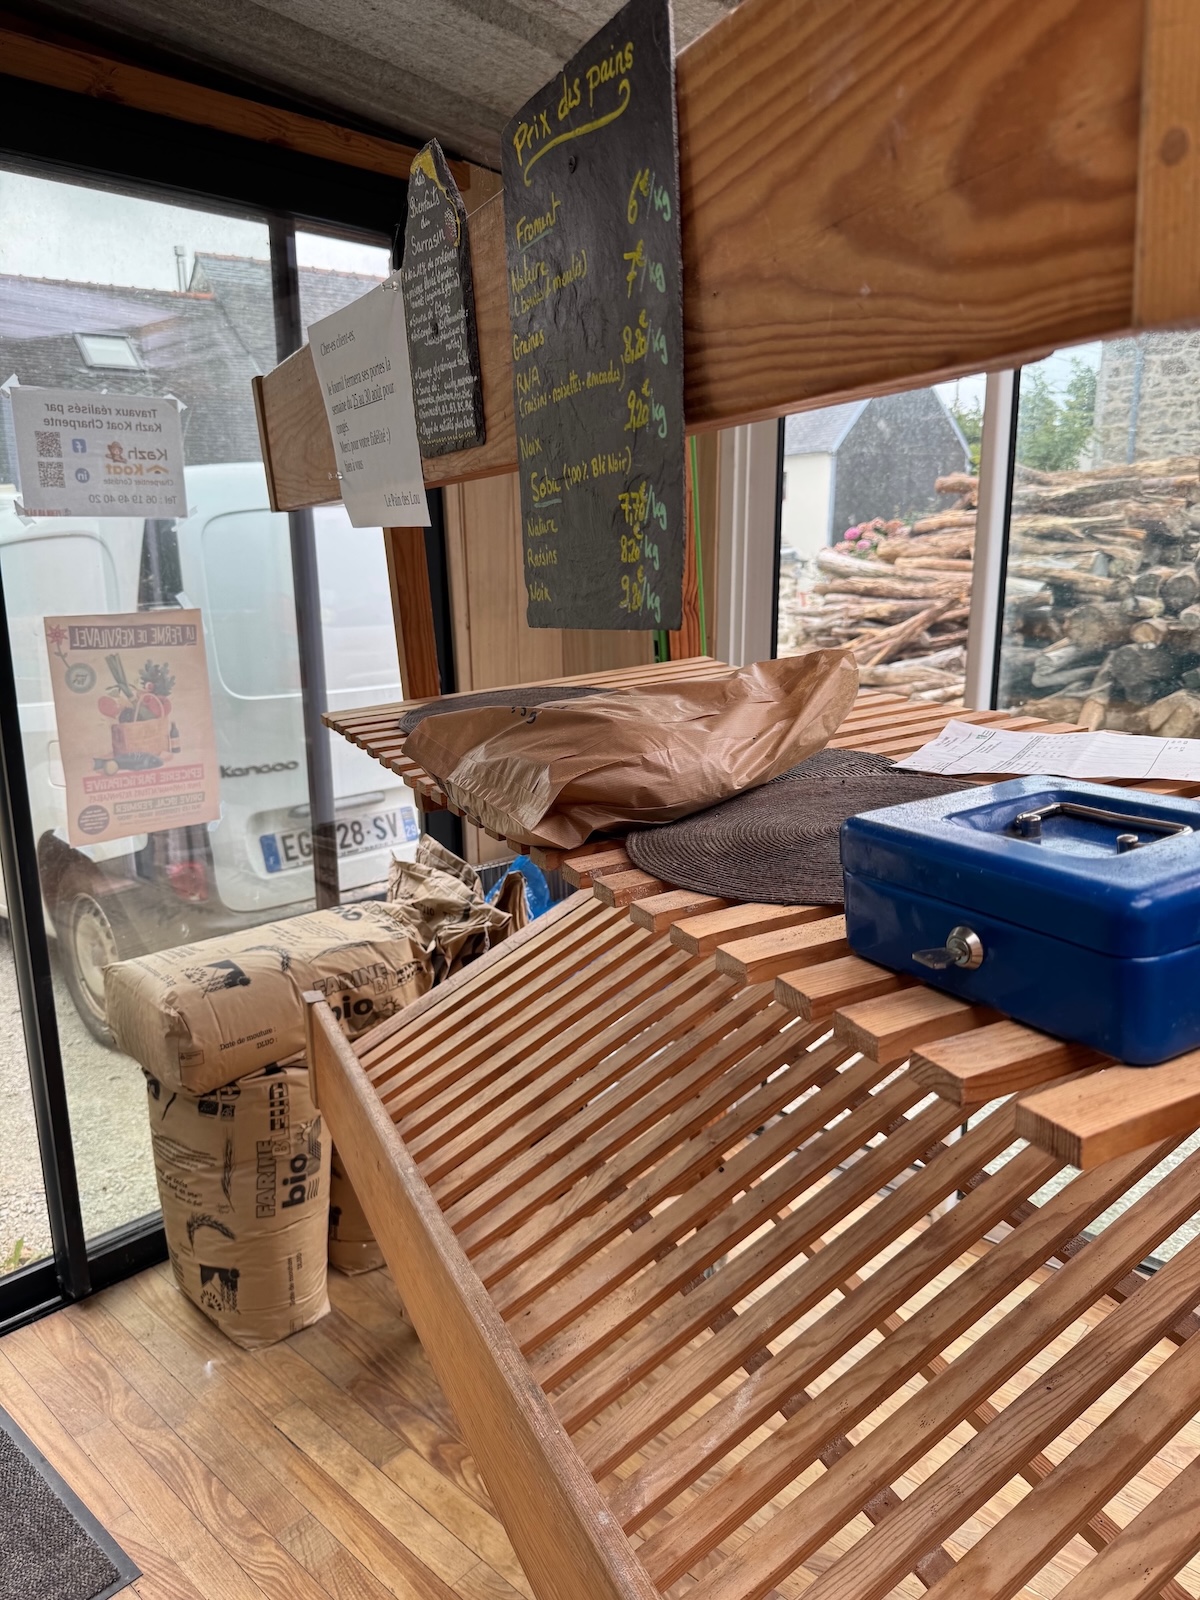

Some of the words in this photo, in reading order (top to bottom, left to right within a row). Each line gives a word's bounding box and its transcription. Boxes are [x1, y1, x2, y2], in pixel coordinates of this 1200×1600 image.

[513, 110, 551, 166] Prix
[558, 73, 581, 121] des
[586, 42, 634, 108] pains
[409, 187, 440, 219] Bienfaits
[516, 191, 561, 250] Froment
[411, 225, 446, 256] Sarrasin
[511, 254, 549, 296] Nature
[513, 329, 545, 361] Graines
[370, 362, 385, 382] portes
[385, 356, 391, 371] la
[516, 365, 541, 397] RNA
[382, 383, 395, 400] pour
[359, 436, 370, 449] votre
[370, 428, 386, 446] fidélité
[520, 434, 543, 461] Noix
[401, 491, 410, 506] des
[527, 516, 558, 537] Nature
[527, 544, 558, 568] Raisins
[405, 824, 418, 838] 29
[220, 1041, 235, 1051] Date
[246, 1028, 273, 1042] mouture
[256, 1140, 276, 1218] FARINE
[281, 1153, 308, 1208] bio
